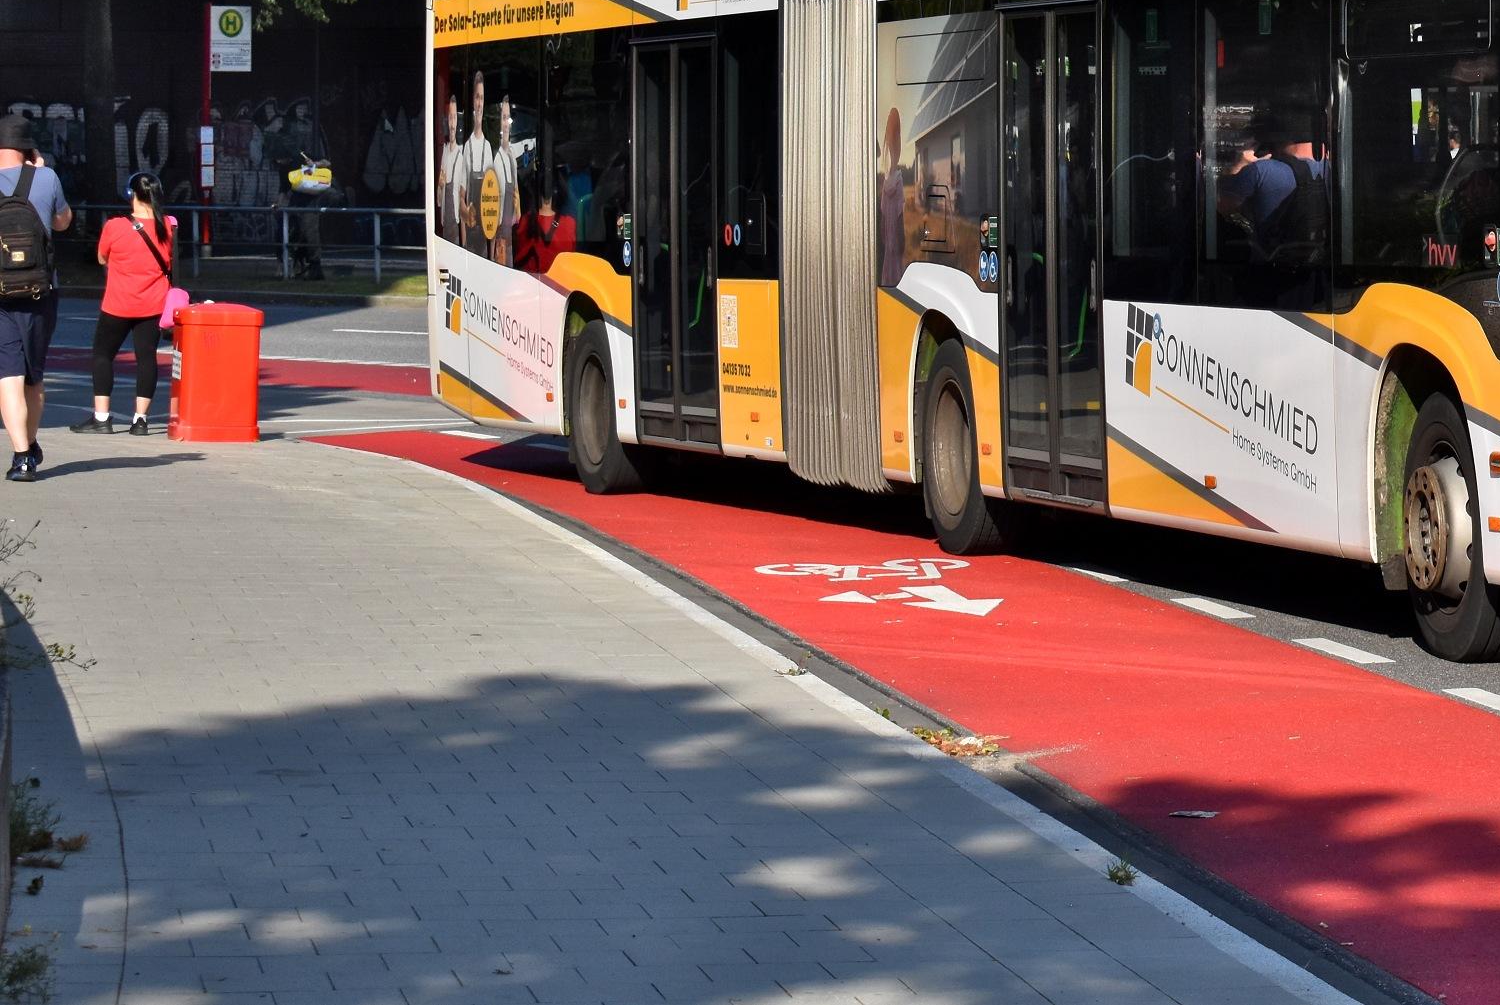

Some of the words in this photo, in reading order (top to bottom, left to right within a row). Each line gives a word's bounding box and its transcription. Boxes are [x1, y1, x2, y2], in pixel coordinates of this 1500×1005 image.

[225, 15, 237, 31] H
[434, 15, 447, 35] Der
[448, 7, 502, 34] Solar-Experte
[503, 4, 515, 25] für
[516, 2, 545, 22] unsere
[1428, 237, 1457, 266] hvv
[463, 287, 554, 368] SONNENSCHMIED
[722, 362, 737, 375] 04135
[722, 383, 777, 398] www.sonnenschmied.de
[1156, 327, 1318, 455] SONNENSCHMIED
[1232, 427, 1256, 456] Home
[1256, 442, 1289, 476] Systems
[1290, 462, 1317, 494] GmbH
